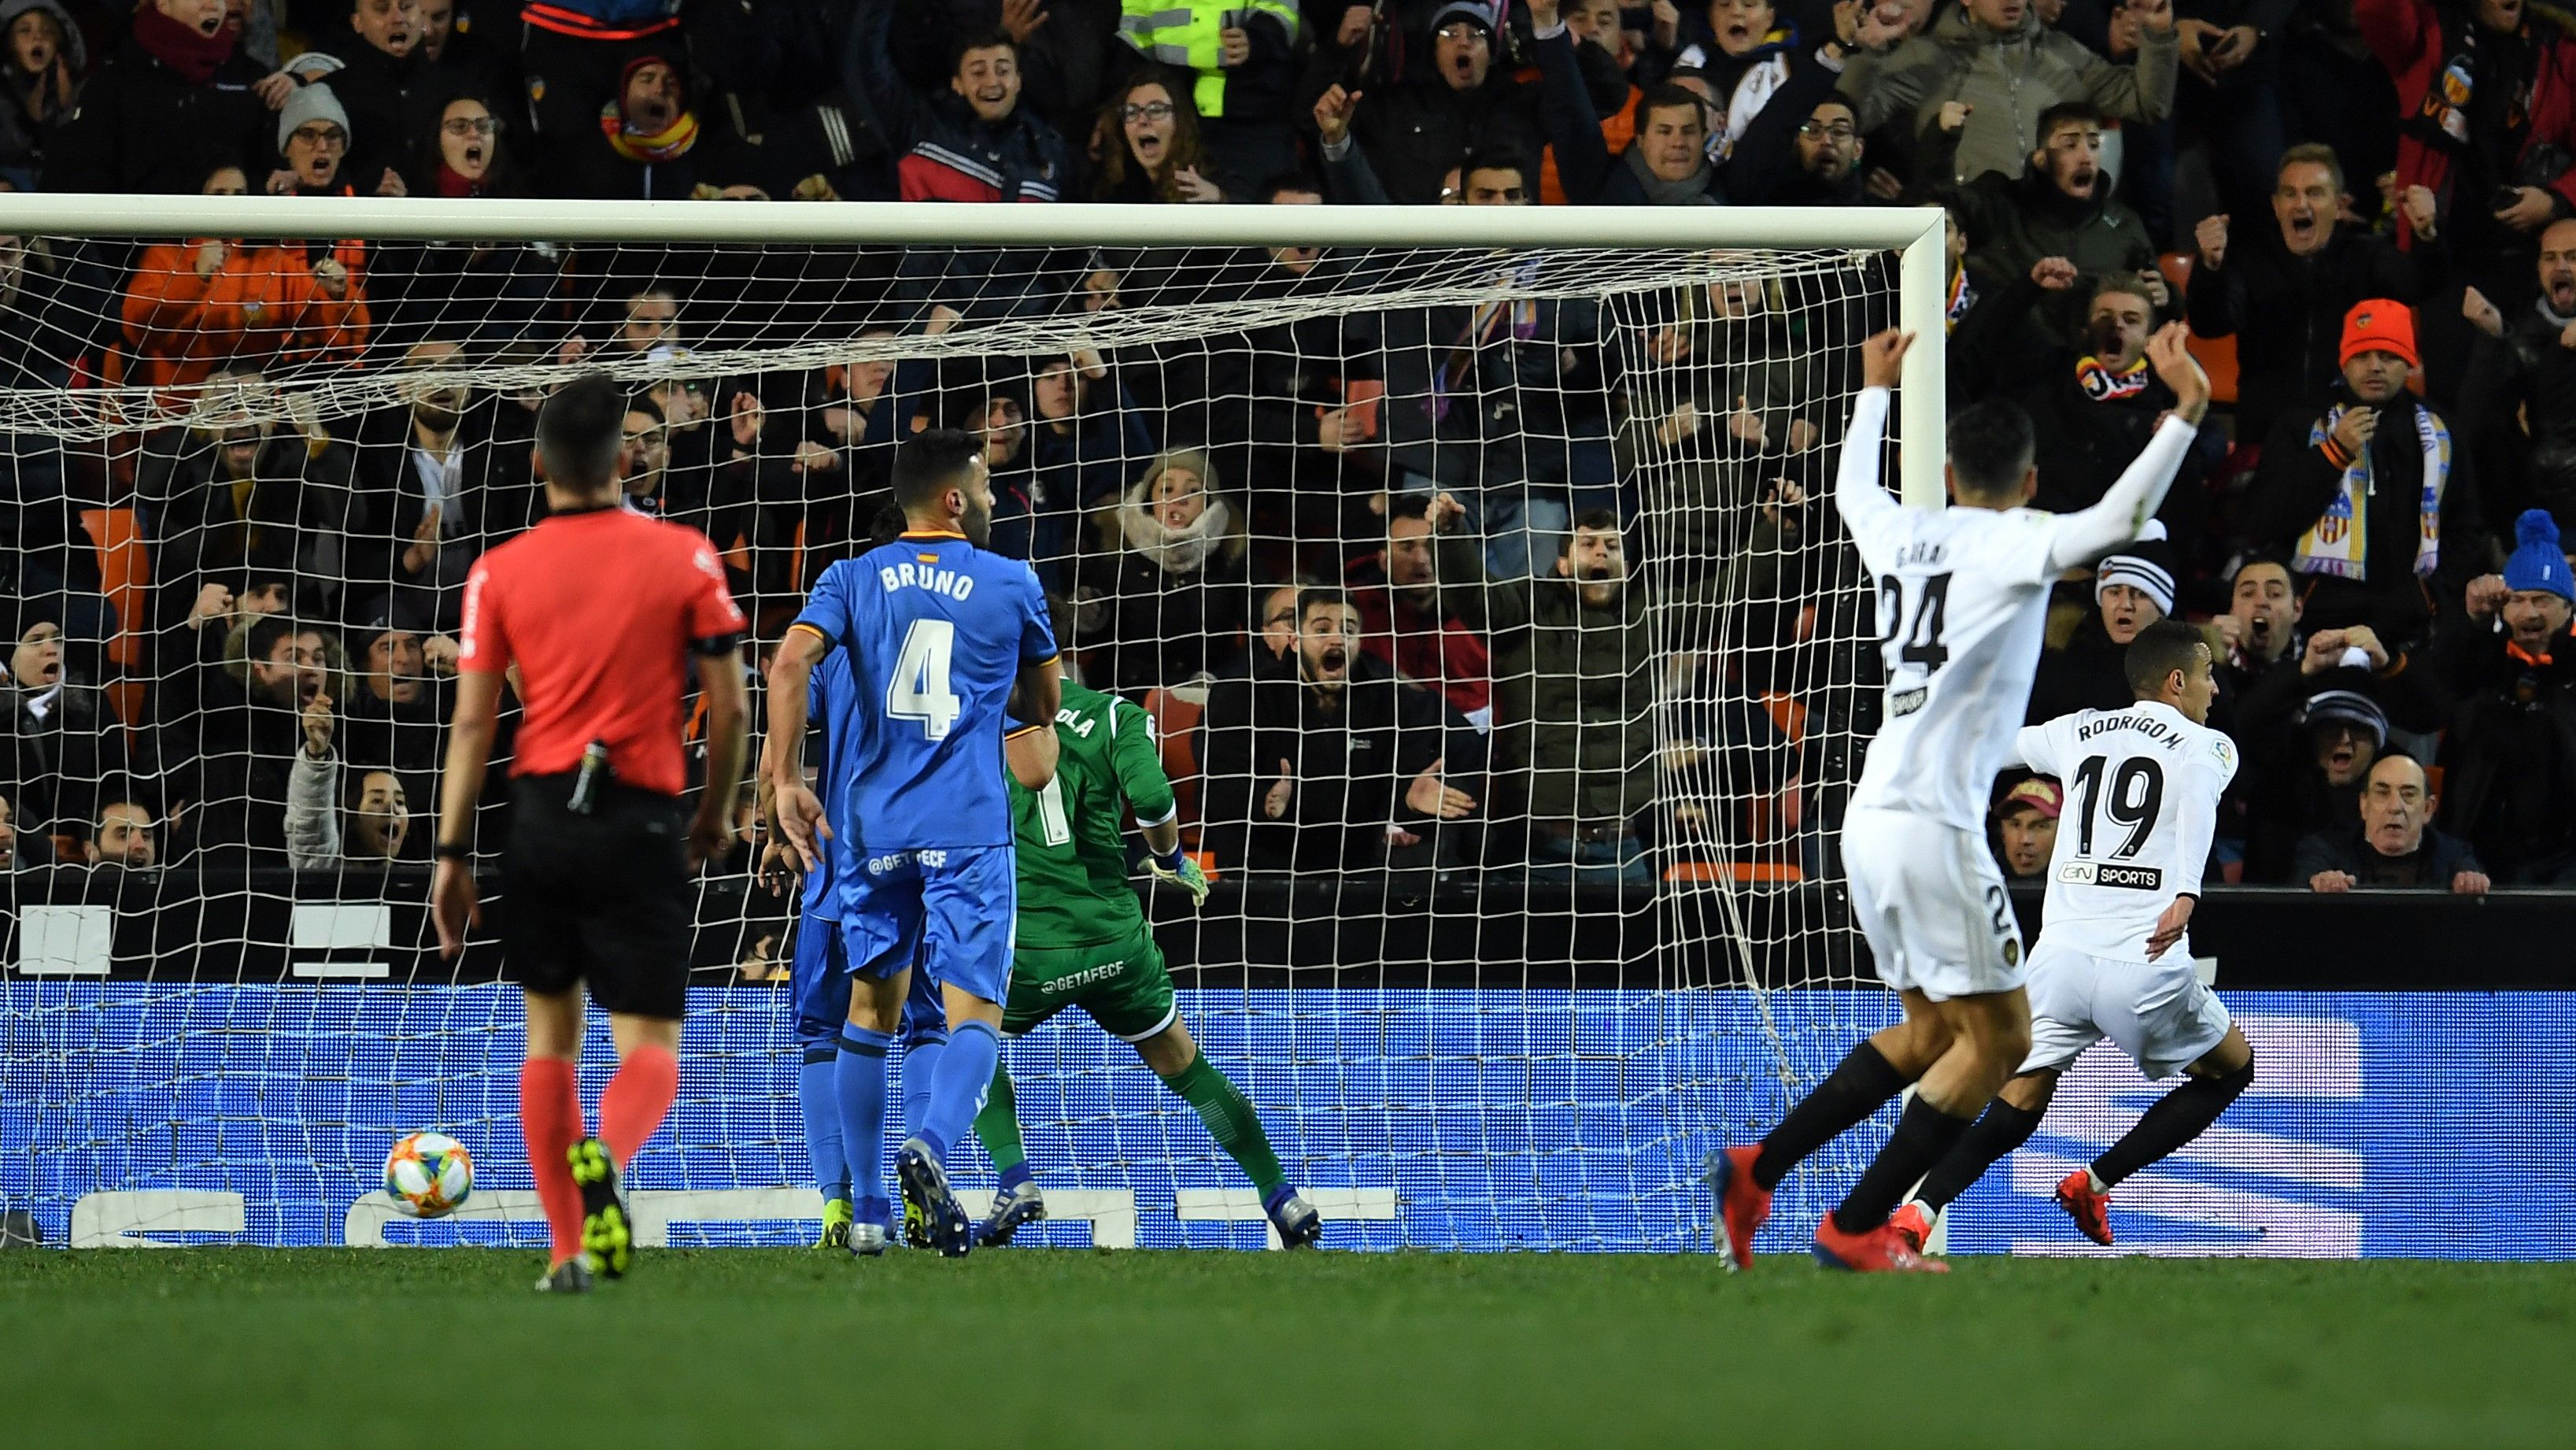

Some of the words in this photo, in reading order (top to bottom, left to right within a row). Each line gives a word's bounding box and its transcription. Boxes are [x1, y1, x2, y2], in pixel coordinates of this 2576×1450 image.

[881, 563, 974, 601] BRUNO
[1880, 571, 1953, 682] 24
[887, 618, 960, 741] 4
[1055, 708, 1096, 738] OLA
[2079, 716, 2167, 742] RODRIGO
[2072, 755, 2164, 860] 19
[868, 849, 947, 875] @GETECF
[2101, 868, 2157, 886] SPORTS
[1040, 960, 1124, 994] @GETAFECF
